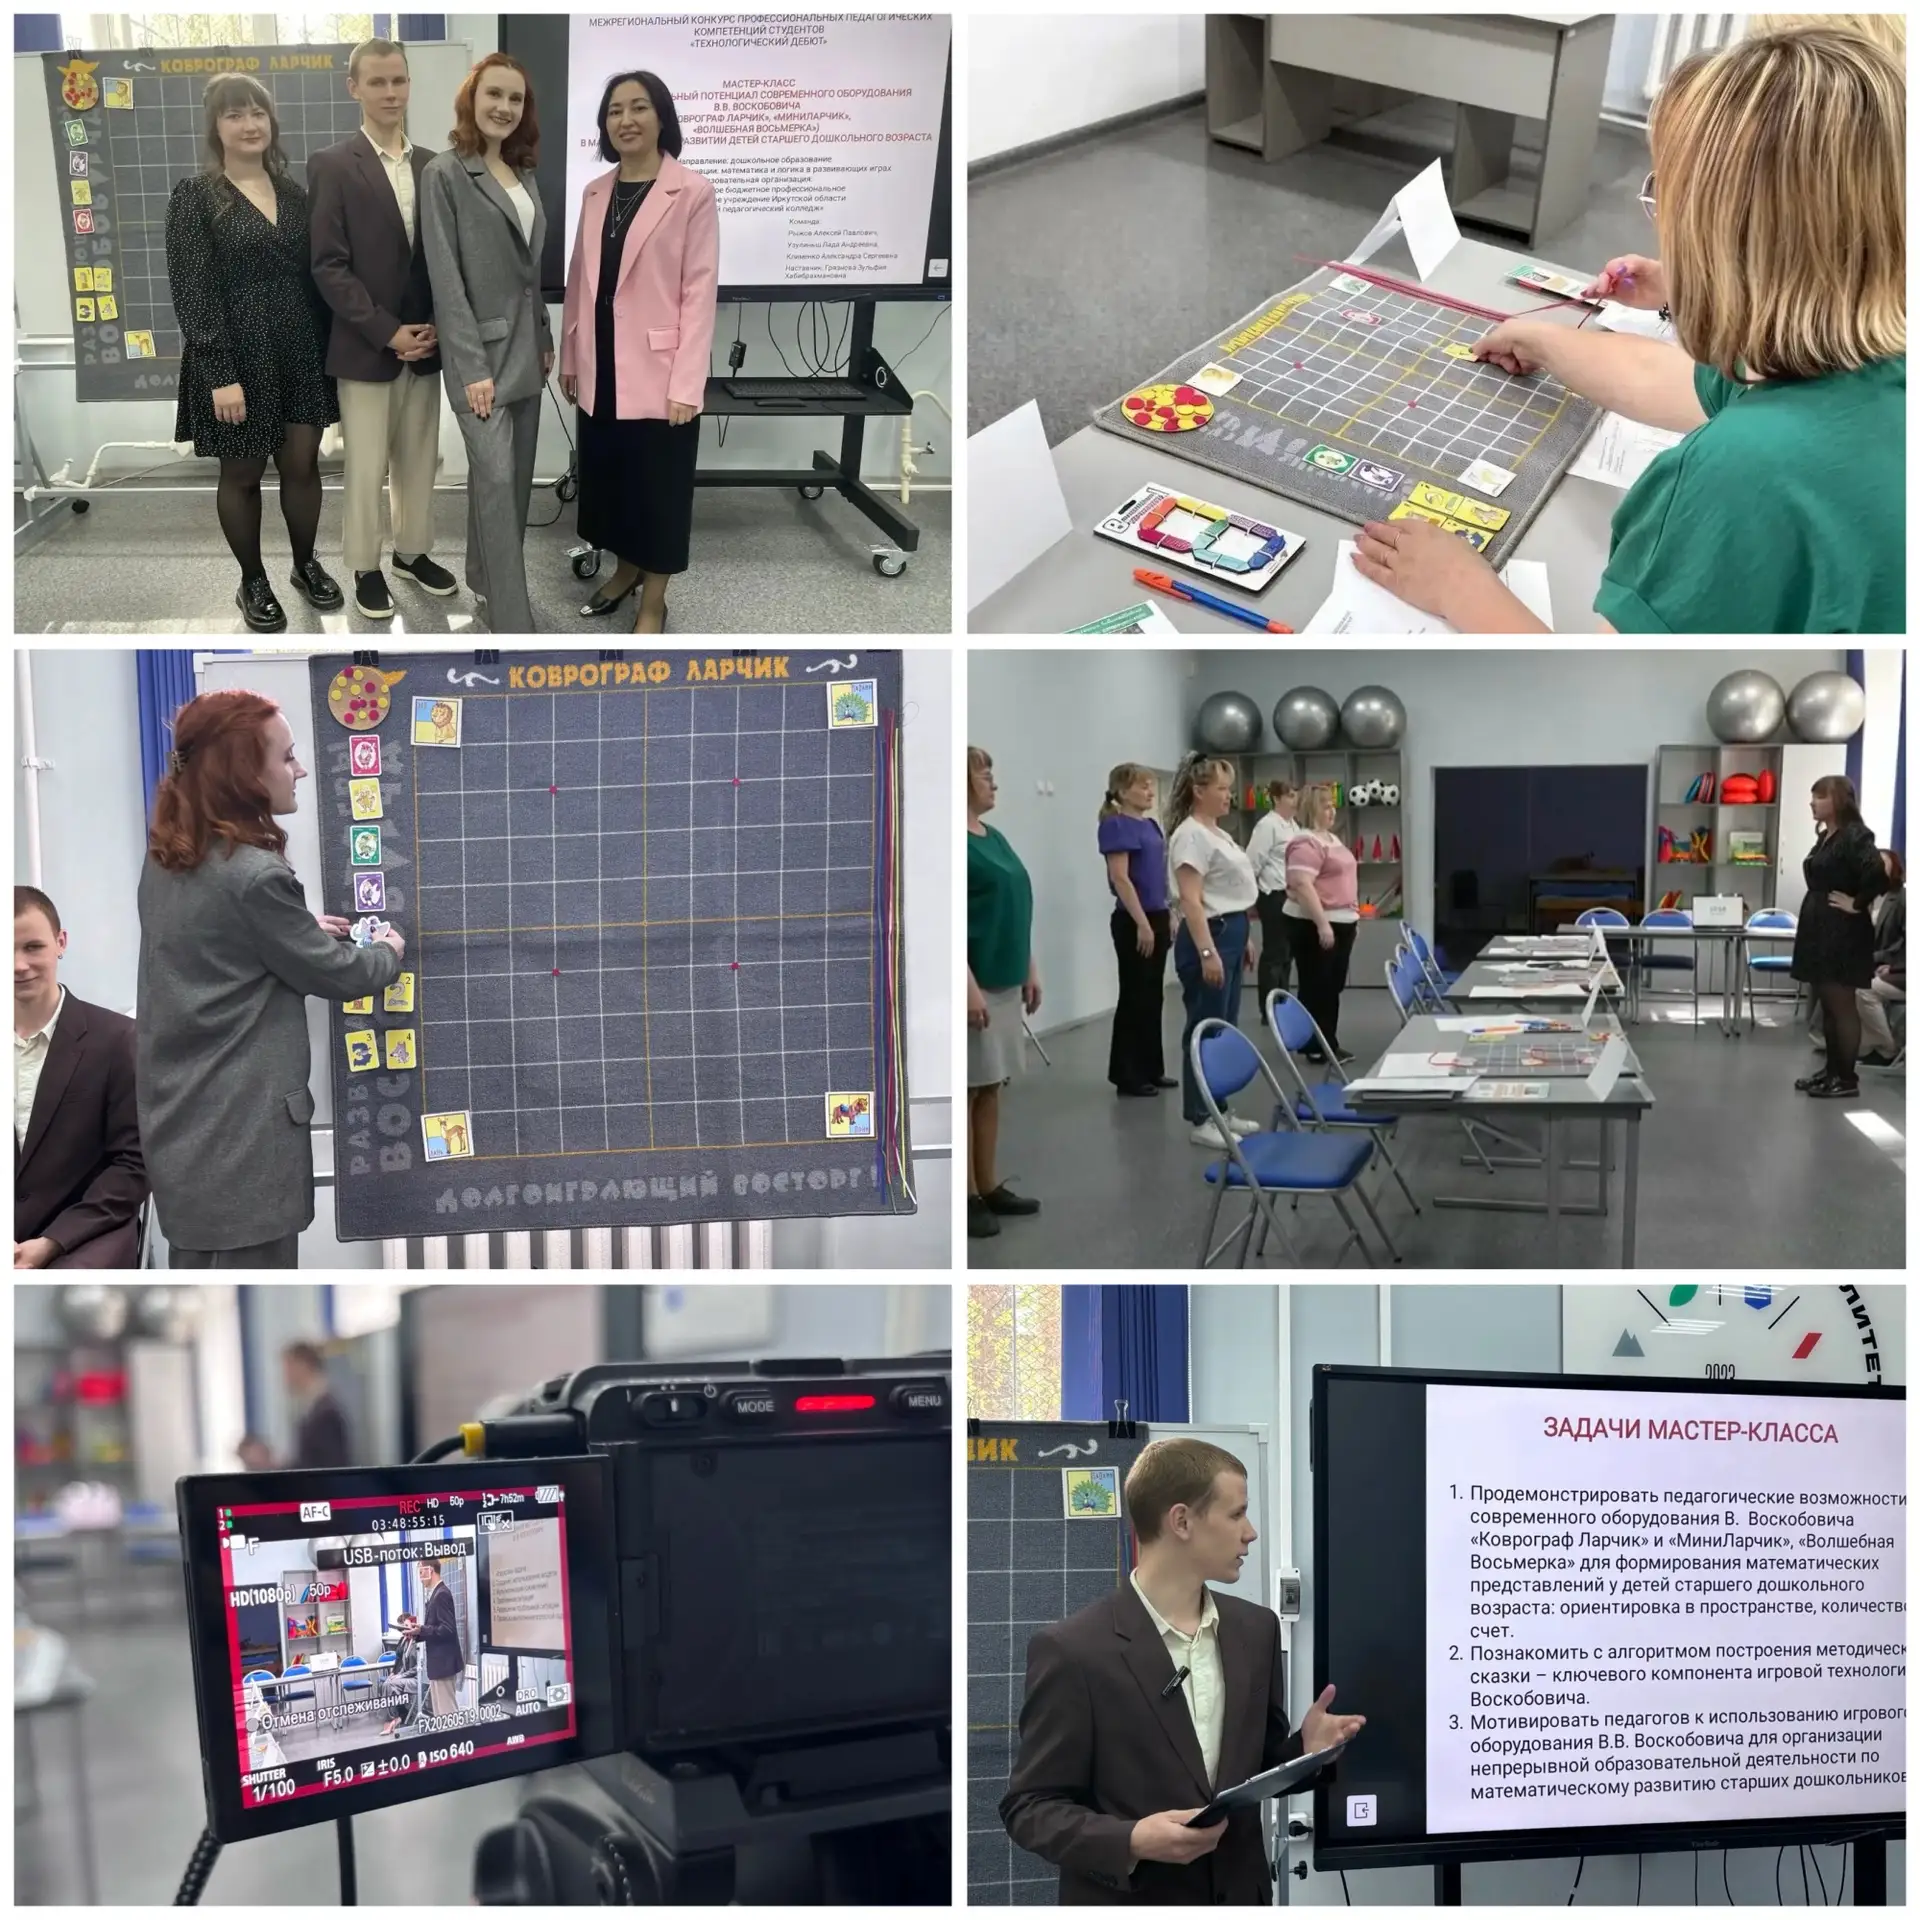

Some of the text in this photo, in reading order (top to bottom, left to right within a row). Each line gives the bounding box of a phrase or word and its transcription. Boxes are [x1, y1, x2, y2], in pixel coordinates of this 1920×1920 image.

[589, 15, 690, 27] МЕЖРЕГИОНАЛЬНЫЙ
[691, 15, 736, 25] КОНКУРС
[737, 13, 844, 24] ПРОФЕССИОНАЛЬНЫХ
[694, 25, 825, 37] КОМПЕТЕНЦИЙ СТУДЕНТОВ
[690, 37, 828, 48] «ТЕХНОЛОГИЧЕСКИЙ ДЕБЮТ»
[161, 54, 334, 74] КОВРОГРАФ ЛАРЧИК
[722, 79, 796, 88] МАСТЕР-КЛАСС
[700, 91, 758, 101] ПОТЕНЦИАЛ
[760, 89, 835, 99] СОВРЕМЕННОГО
[836, 88, 912, 98] ОБОРУДОВАНИЯ
[714, 102, 801, 111] В.В. ВОСКОБОВИЧА
[693, 125, 755, 134] «ВОЛШЕБНАЯ
[729, 134, 759, 145] ДЕТЕЙ
[760, 135, 810, 144] СТАРШЕГО
[811, 134, 884, 144] ДОШКОЛЬНОГО
[885, 132, 933, 142] ВОЗРАСТА
[730, 157, 780, 165] дошкольное
[781, 156, 832, 165] образование
[508, 656, 791, 688] КОВРОГРАФ ЛАРЧИК
[405, 976, 411, 985] 2
[366, 1033, 372, 1042] 3
[406, 1032, 412, 1041] 4
[436, 1168, 718, 1213] ДОЛГОИГРАЮЩИЙ
[737, 1401, 775, 1413] MODE
[908, 1396, 943, 1408] MENU
[1543, 1416, 1840, 1444] ЗАДАЧИ МАСТЕР-КЛАССА
[1450, 1484, 1463, 1500] 1.
[1470, 1485, 1659, 1506] Продемонстрировать
[1663, 1490, 1795, 1507] педагогические
[303, 1506, 329, 1519] AF-C
[399, 1499, 421, 1514] REC
[427, 1498, 439, 1509] HD
[371, 1514, 446, 1532] 03:48:55:15
[1470, 1509, 1855, 1529] современного оборудования В. Воскобовича
[1470, 1531, 1895, 1551] «Коврограф Ларчик» и «МиниЛарчик», «Волшебная
[1470, 1554, 1880, 1573] Восьмерка» для формирования математических
[229, 1582, 331, 1608] HD(1080p) 50p
[1470, 1577, 1865, 1596] представлений у детей старшего дошкольного
[1470, 1602, 1556, 1619] возраста:
[1560, 1601, 1680, 1618] ориентировка
[1685, 1602, 1695, 1614] в
[1699, 1600, 1817, 1617] пространстве,
[1470, 1625, 1515, 1639] счет.
[1449, 1645, 1463, 1661] 2.
[1470, 1645, 1589, 1661] Познакомить
[1593, 1647, 1603, 1660] с
[1607, 1646, 1711, 1663] алгоритмом
[1716, 1645, 1812, 1661] построения
[1470, 1663, 1906, 1684] сказки ключевого компонента игровой технологи
[516, 1687, 537, 1702] DRO
[1470, 1690, 1590, 1707] Воскобовича.
[261, 1693, 410, 1731] Отмена отслеживания
[515, 1701, 541, 1717] AUTO
[1449, 1715, 1463, 1730] 3.
[1470, 1714, 1600, 1732] Мотивировать
[1604, 1713, 1690, 1729] педагогов
[1695, 1713, 1704, 1724] к
[1708, 1709, 1838, 1725] использованию
[506, 1733, 526, 1747] AWB
[1470, 1729, 1882, 1756] оборудования В.В. Воскобовича для организации
[253, 1778, 296, 1803] 1/100
[323, 1766, 354, 1788] F5.0
[429, 1748, 448, 1764] ISO
[449, 1739, 475, 1760] 640
[316, 1757, 337, 1772] IRIS
[1470, 1751, 1880, 1778] непрерывной образовательной деятельности по
[241, 1768, 287, 1788] SHUTTER
[1470, 1780, 1630, 1799] математическому
[1634, 1778, 1716, 1796] развитию
[1720, 1775, 1789, 1793] старших
